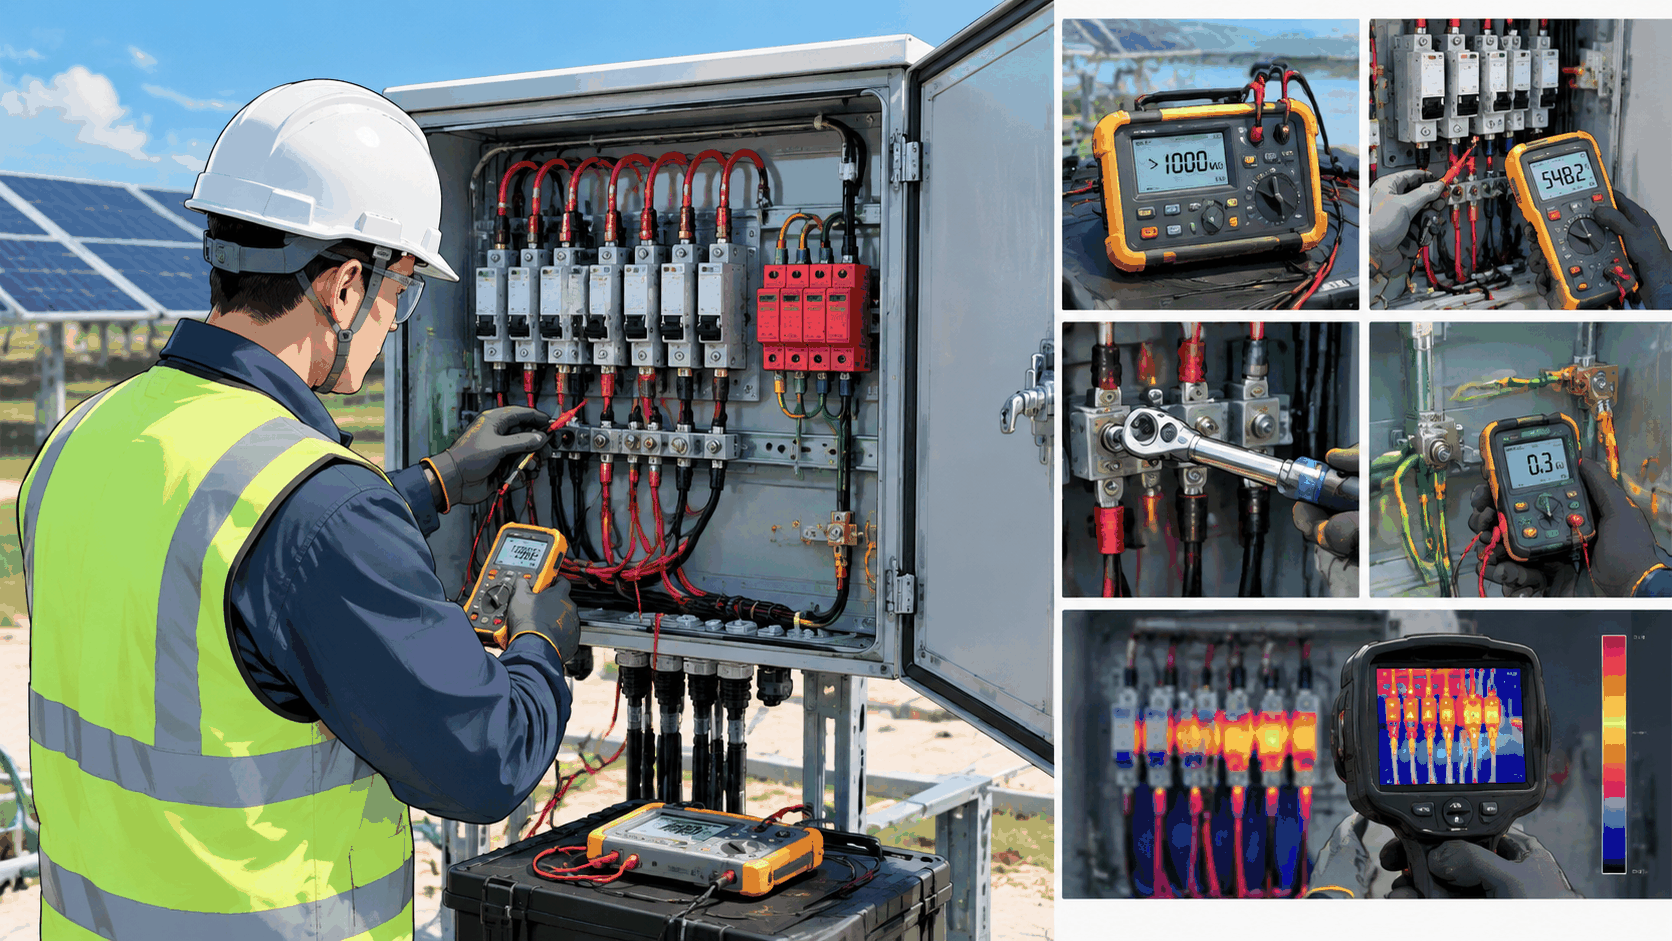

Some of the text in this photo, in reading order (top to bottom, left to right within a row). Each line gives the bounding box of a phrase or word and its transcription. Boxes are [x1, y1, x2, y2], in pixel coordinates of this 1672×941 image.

[1165, 150, 1208, 175] 1000
[1541, 163, 1586, 190] 5482
[1527, 452, 1553, 476] 0.3
